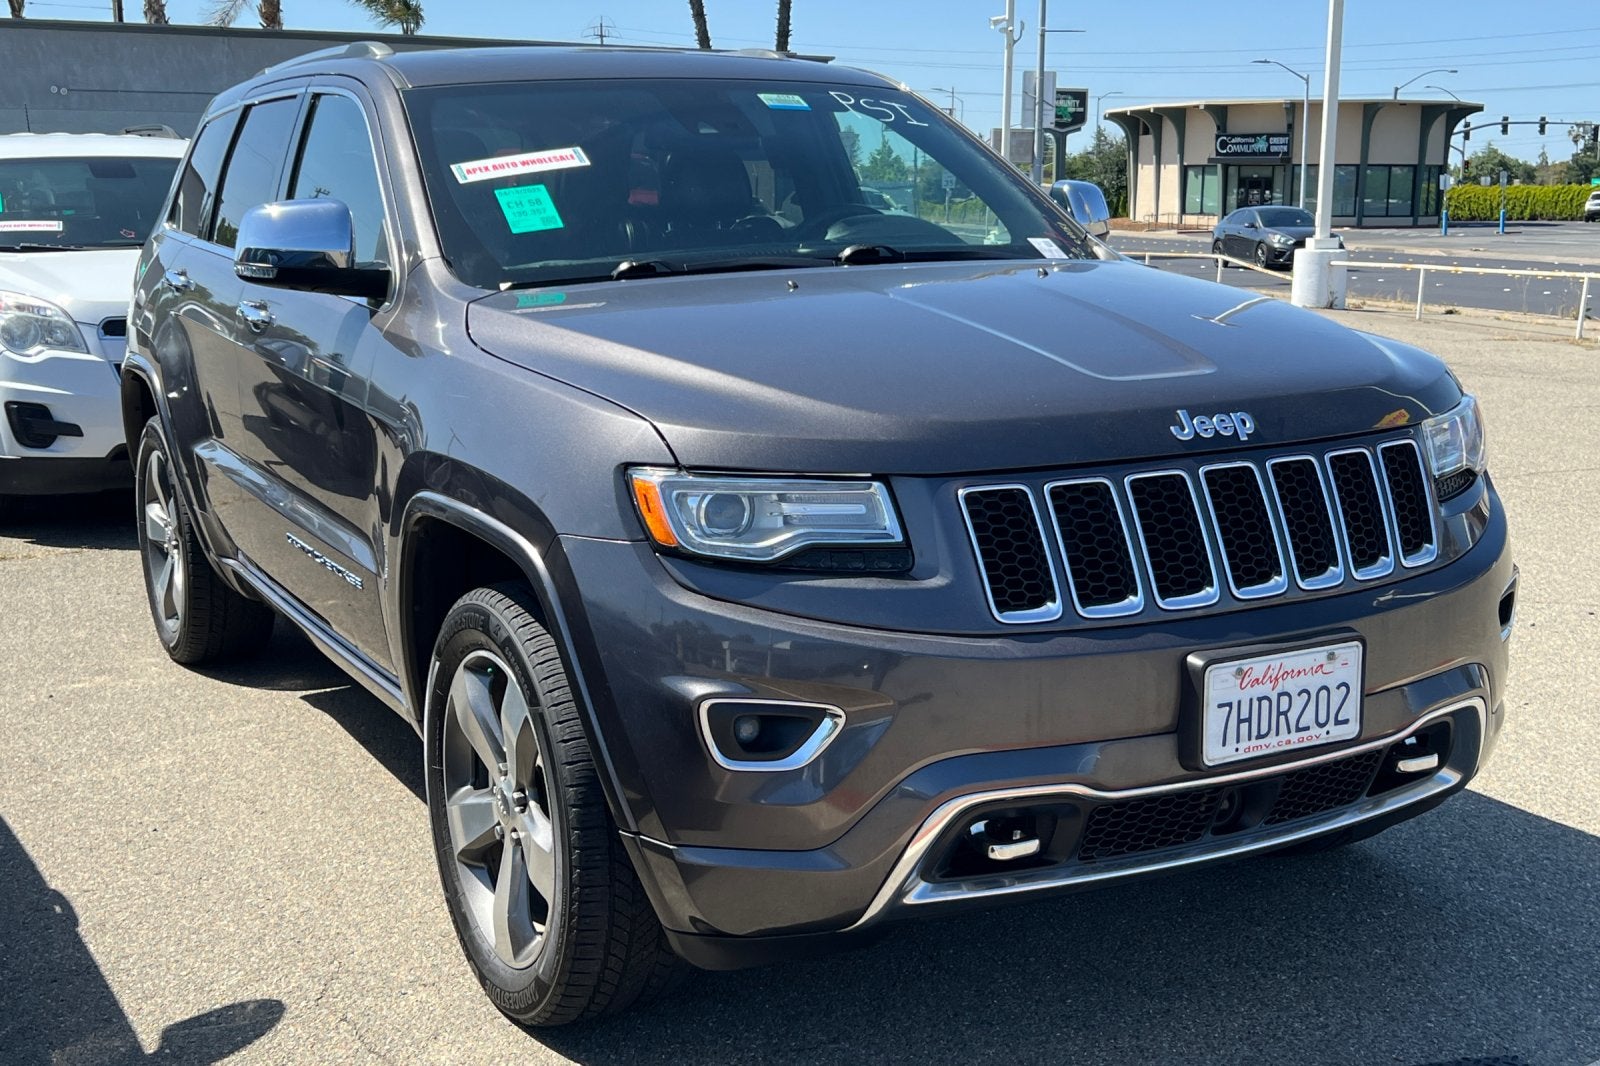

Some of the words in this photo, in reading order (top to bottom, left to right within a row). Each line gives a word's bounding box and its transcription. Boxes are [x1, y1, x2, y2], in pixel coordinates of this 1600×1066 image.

[828, 90, 928, 127] PSI
[466, 166, 490, 176] APEX
[492, 161, 518, 171] AUTO
[519, 153, 576, 168] WHOLESALE
[1169, 409, 1255, 441] Jeep
[1239, 661, 1333, 691] California
[1217, 681, 1350, 748] 7HDR202
[1243, 733, 1322, 754] dmv.ca.gov
